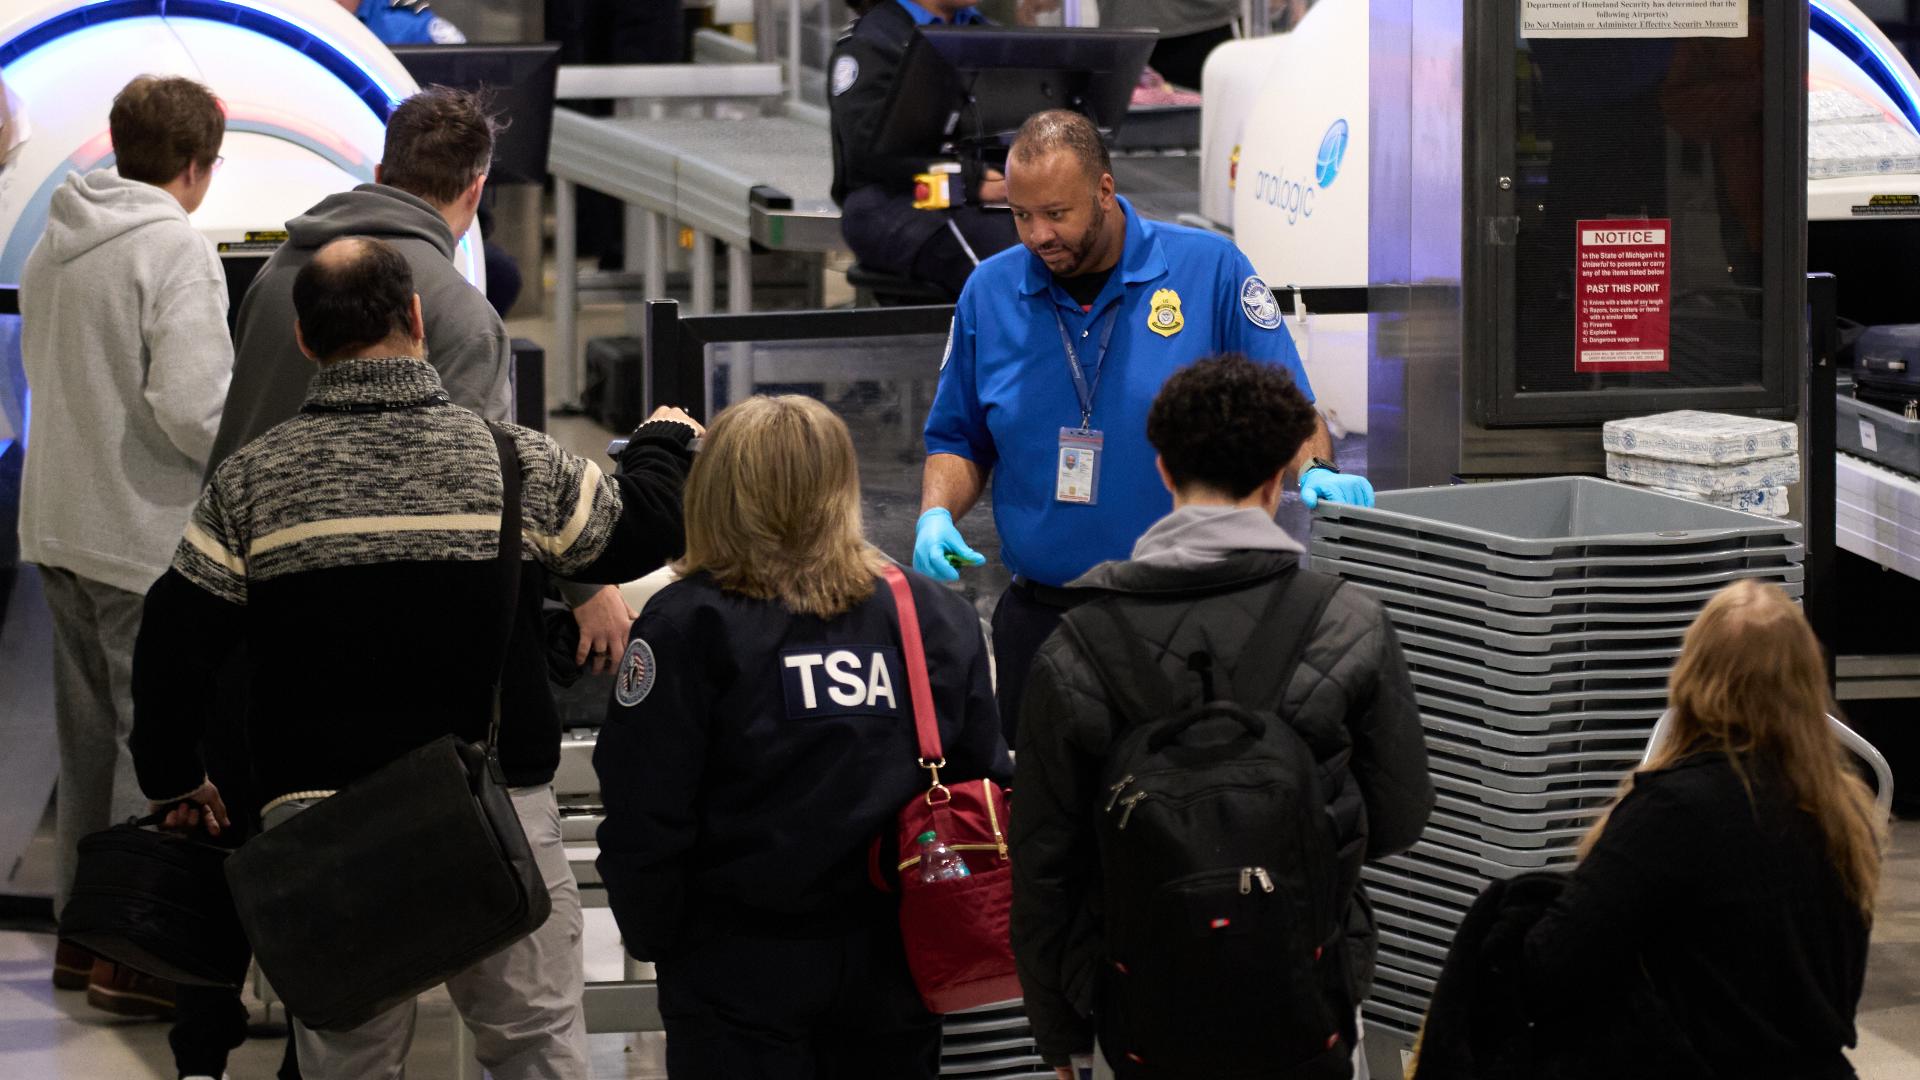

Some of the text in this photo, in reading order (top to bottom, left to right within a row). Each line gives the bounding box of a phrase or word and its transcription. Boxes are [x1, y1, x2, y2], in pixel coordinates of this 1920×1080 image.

[1527, 1, 1570, 10] Department
[1620, 1, 1650, 9] Security
[1596, 11, 1669, 19] following Airport(s)
[1524, 21, 1535, 29] Do
[1537, 21, 1549, 29] Not
[1552, 21, 1585, 29] Maintain
[1598, 21, 1637, 29] Administer
[1640, 20, 1671, 28] Effective
[1673, 20, 1702, 28] Security
[1705, 20, 1738, 28] Measures
[1594, 231, 1653, 244] NOTICE
[1625, 251, 1653, 260] Michigan
[1617, 261, 1641, 269] possess
[1649, 260, 1665, 268] carry
[1586, 283, 1660, 293] PAST THIS POINT
[1648, 298, 1664, 306] length
[784, 650, 897, 709] TSA
